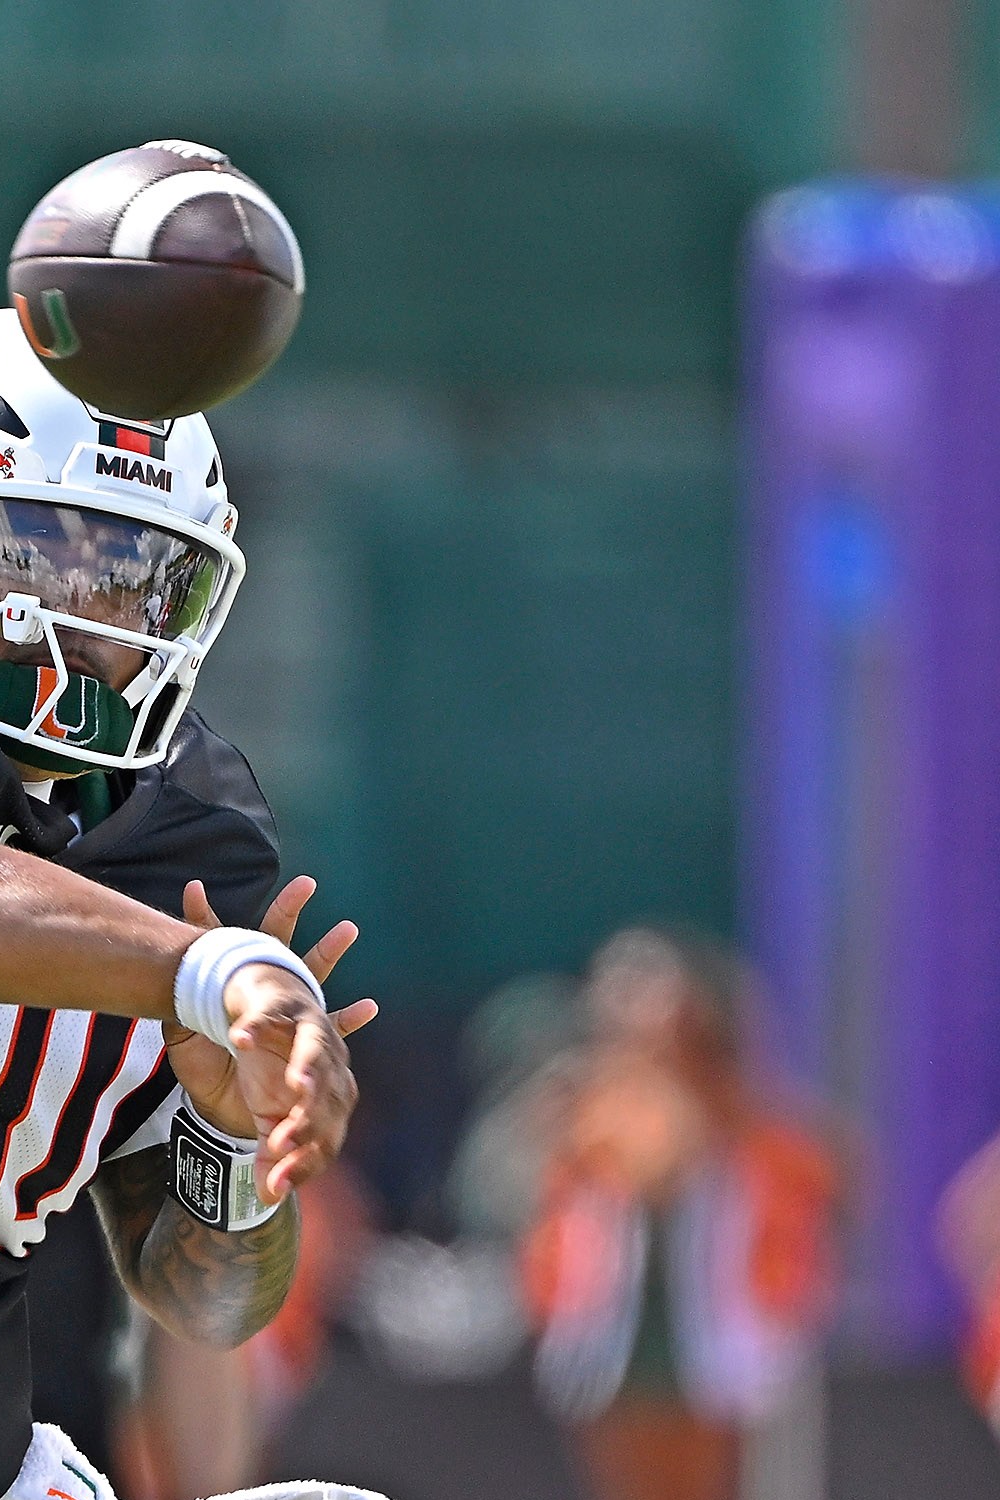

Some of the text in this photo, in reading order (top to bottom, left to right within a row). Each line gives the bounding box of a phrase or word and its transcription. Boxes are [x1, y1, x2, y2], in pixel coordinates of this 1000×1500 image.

[95, 452, 172, 493] MIAMI
[6, 607, 26, 622] U
[31, 666, 99, 746] U
